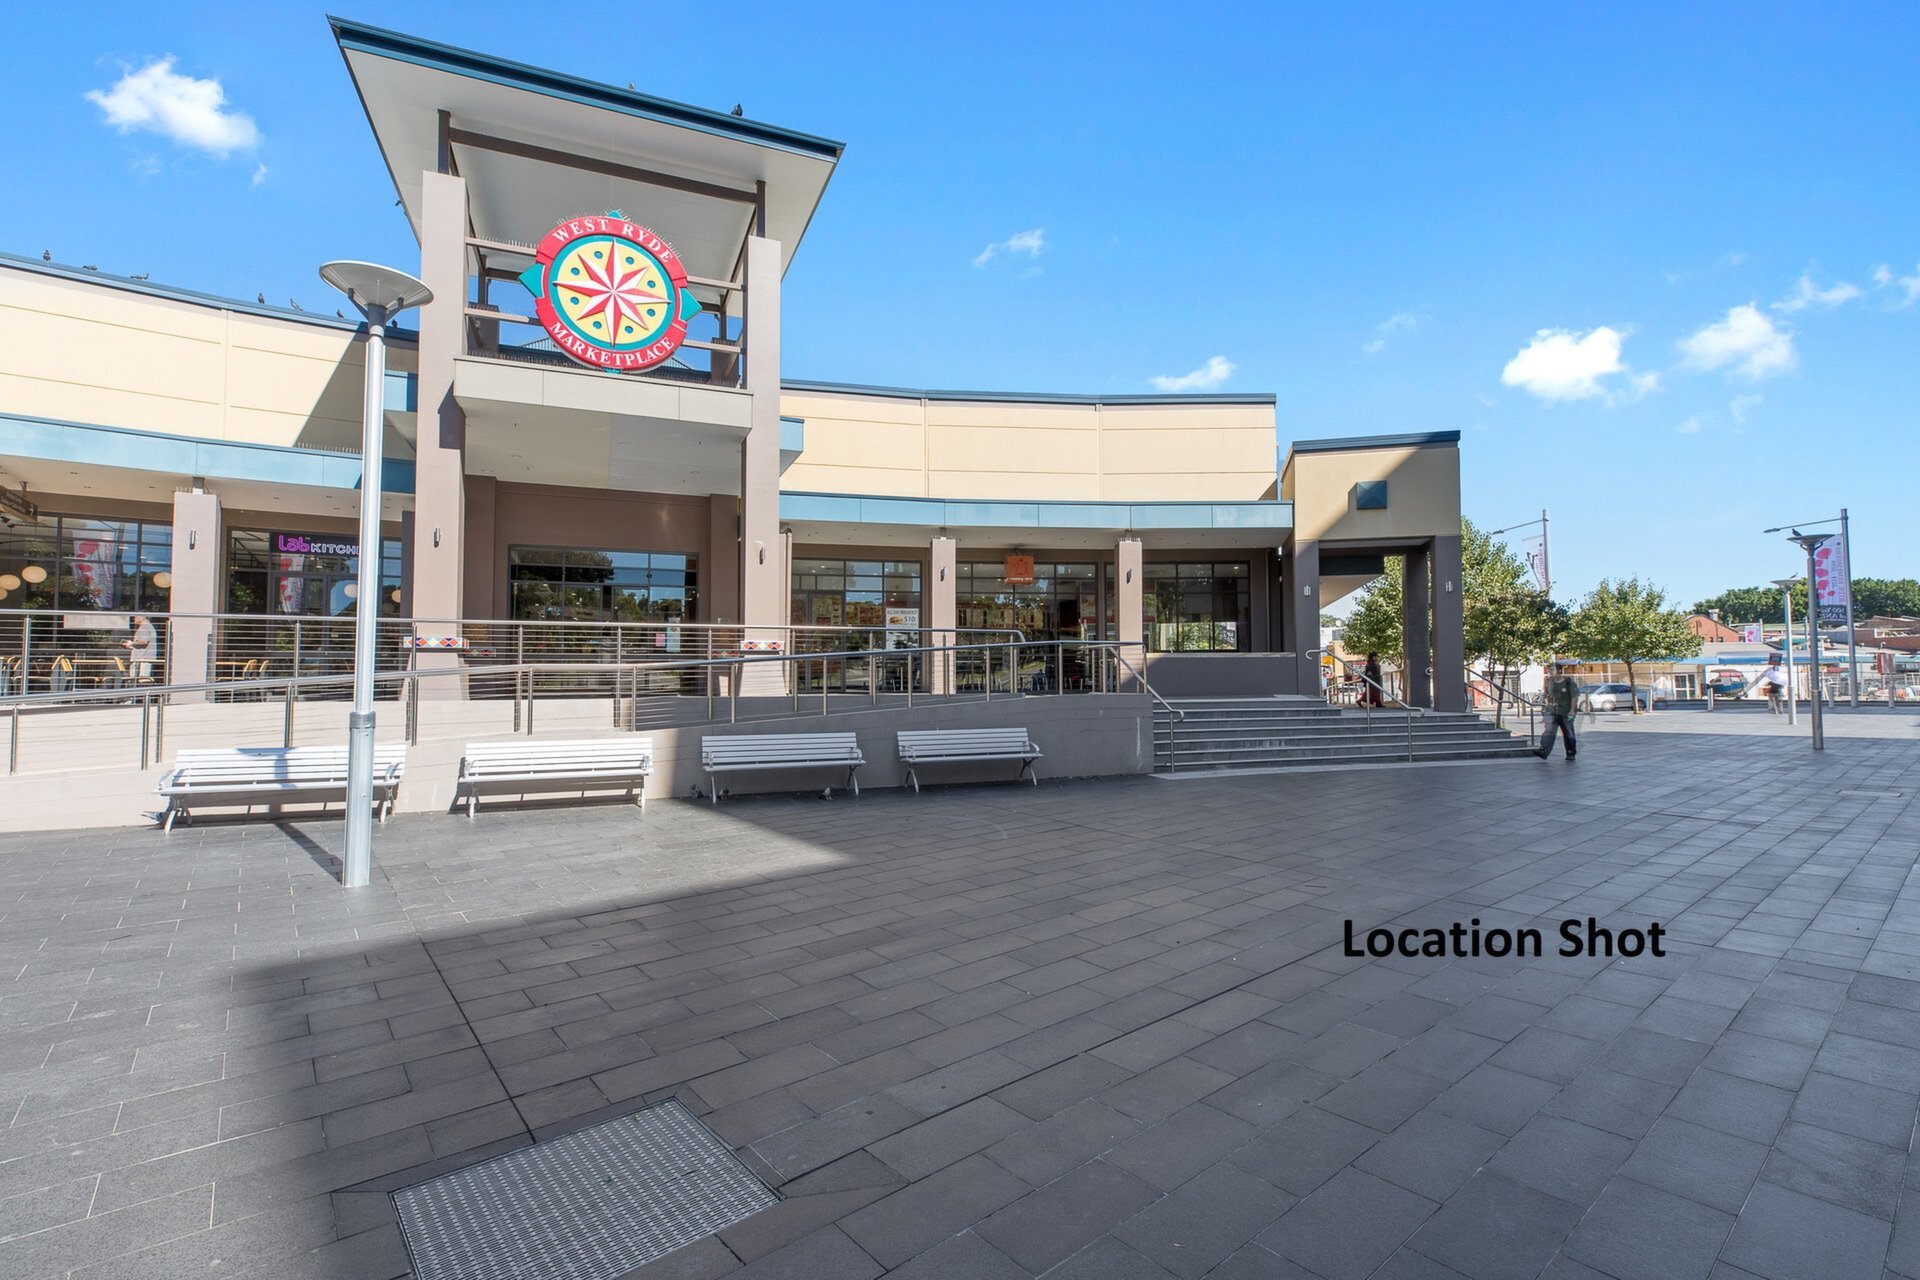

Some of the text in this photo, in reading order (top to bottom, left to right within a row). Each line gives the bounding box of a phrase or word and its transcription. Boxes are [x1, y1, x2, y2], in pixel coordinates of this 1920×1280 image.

[552, 218, 673, 263] WEST RYDE
[550, 322, 675, 366] MARKETPLACE
[278, 534, 360, 555] Lab KITCH
